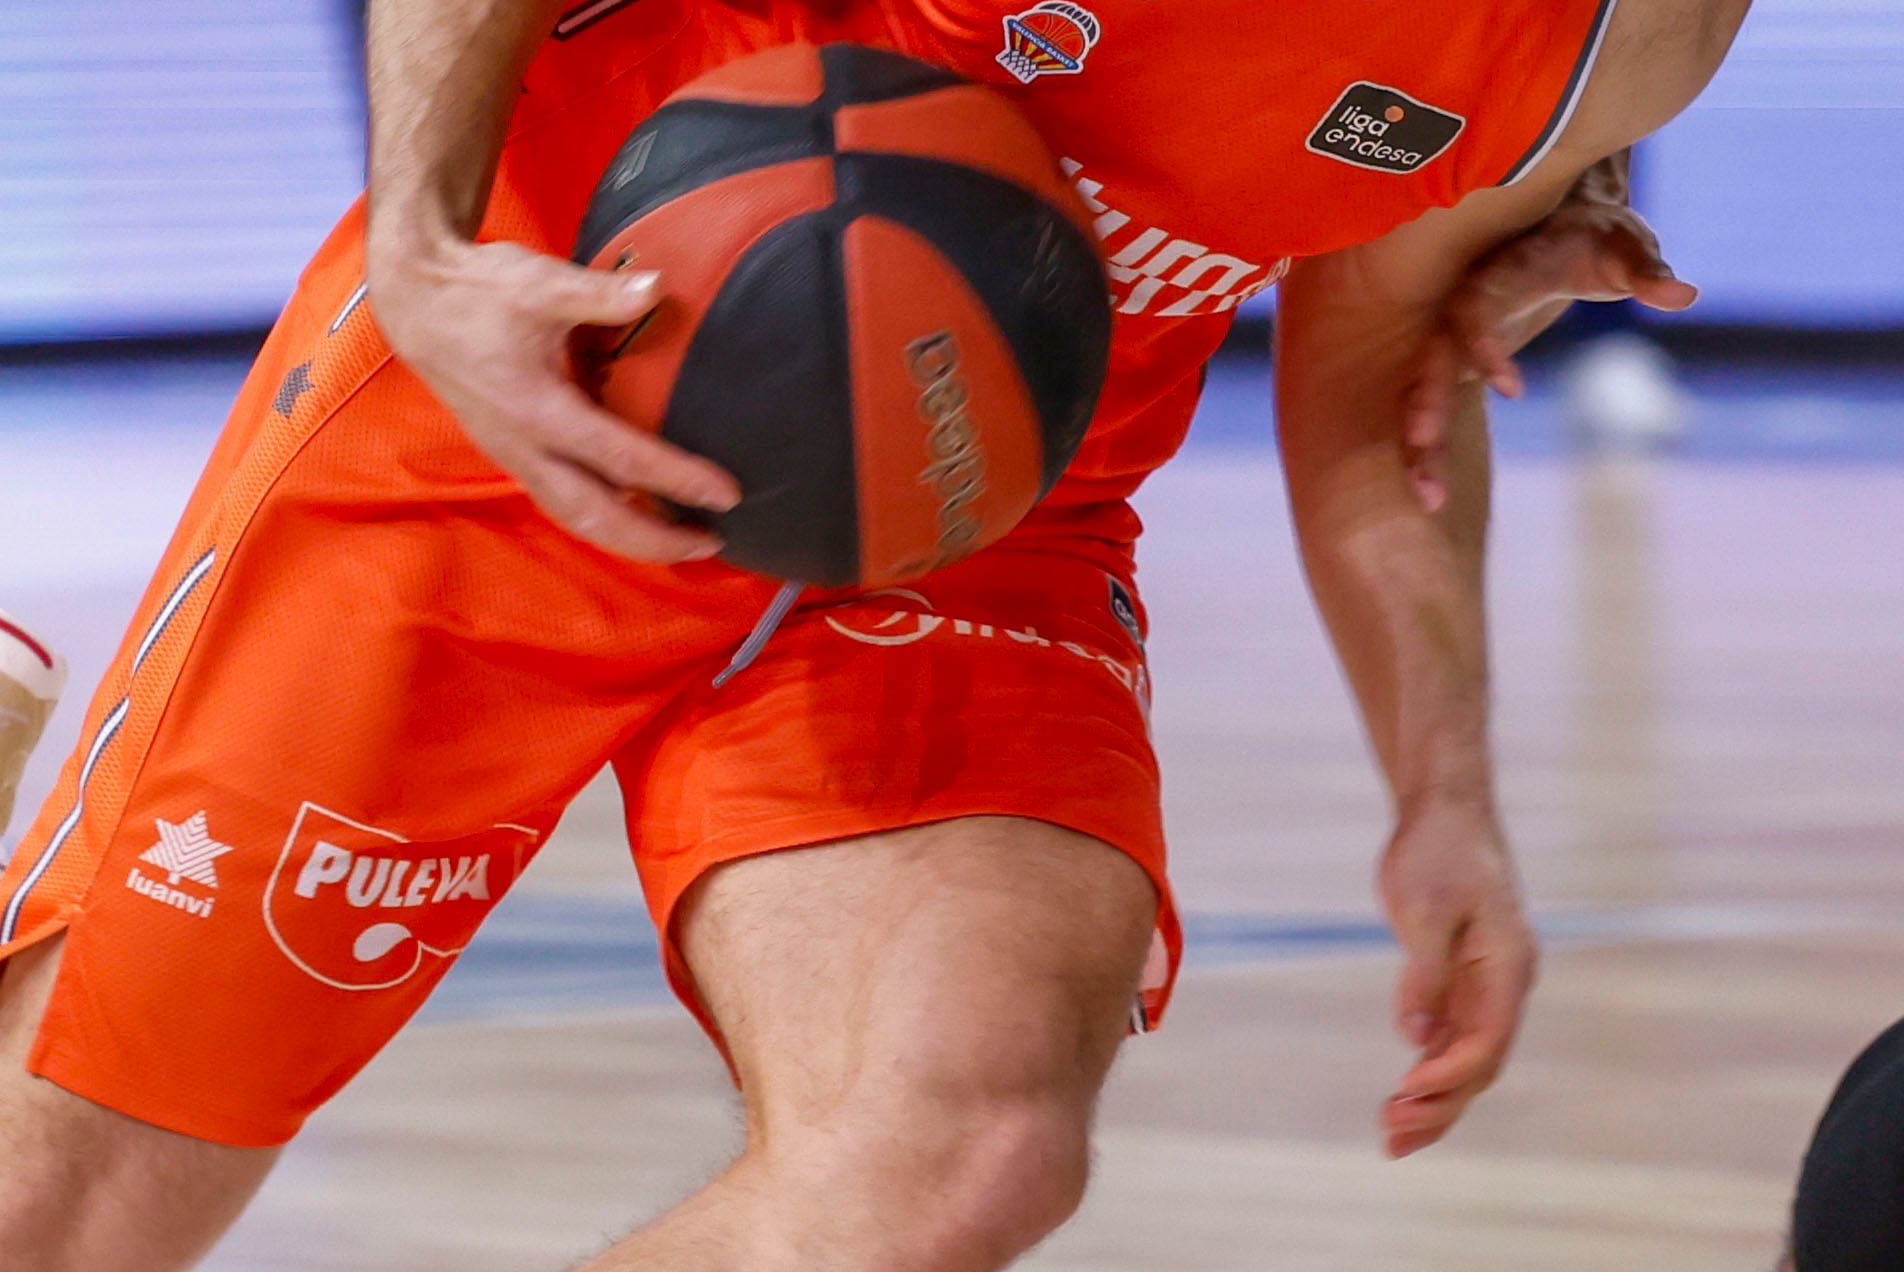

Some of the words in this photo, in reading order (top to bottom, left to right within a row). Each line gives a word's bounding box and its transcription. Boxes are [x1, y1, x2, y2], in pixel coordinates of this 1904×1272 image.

[1338, 105, 1391, 138] liga
[1324, 127, 1423, 166] endesa
[125, 867, 216, 919] luanvi
[293, 840, 491, 909] PULEVA
